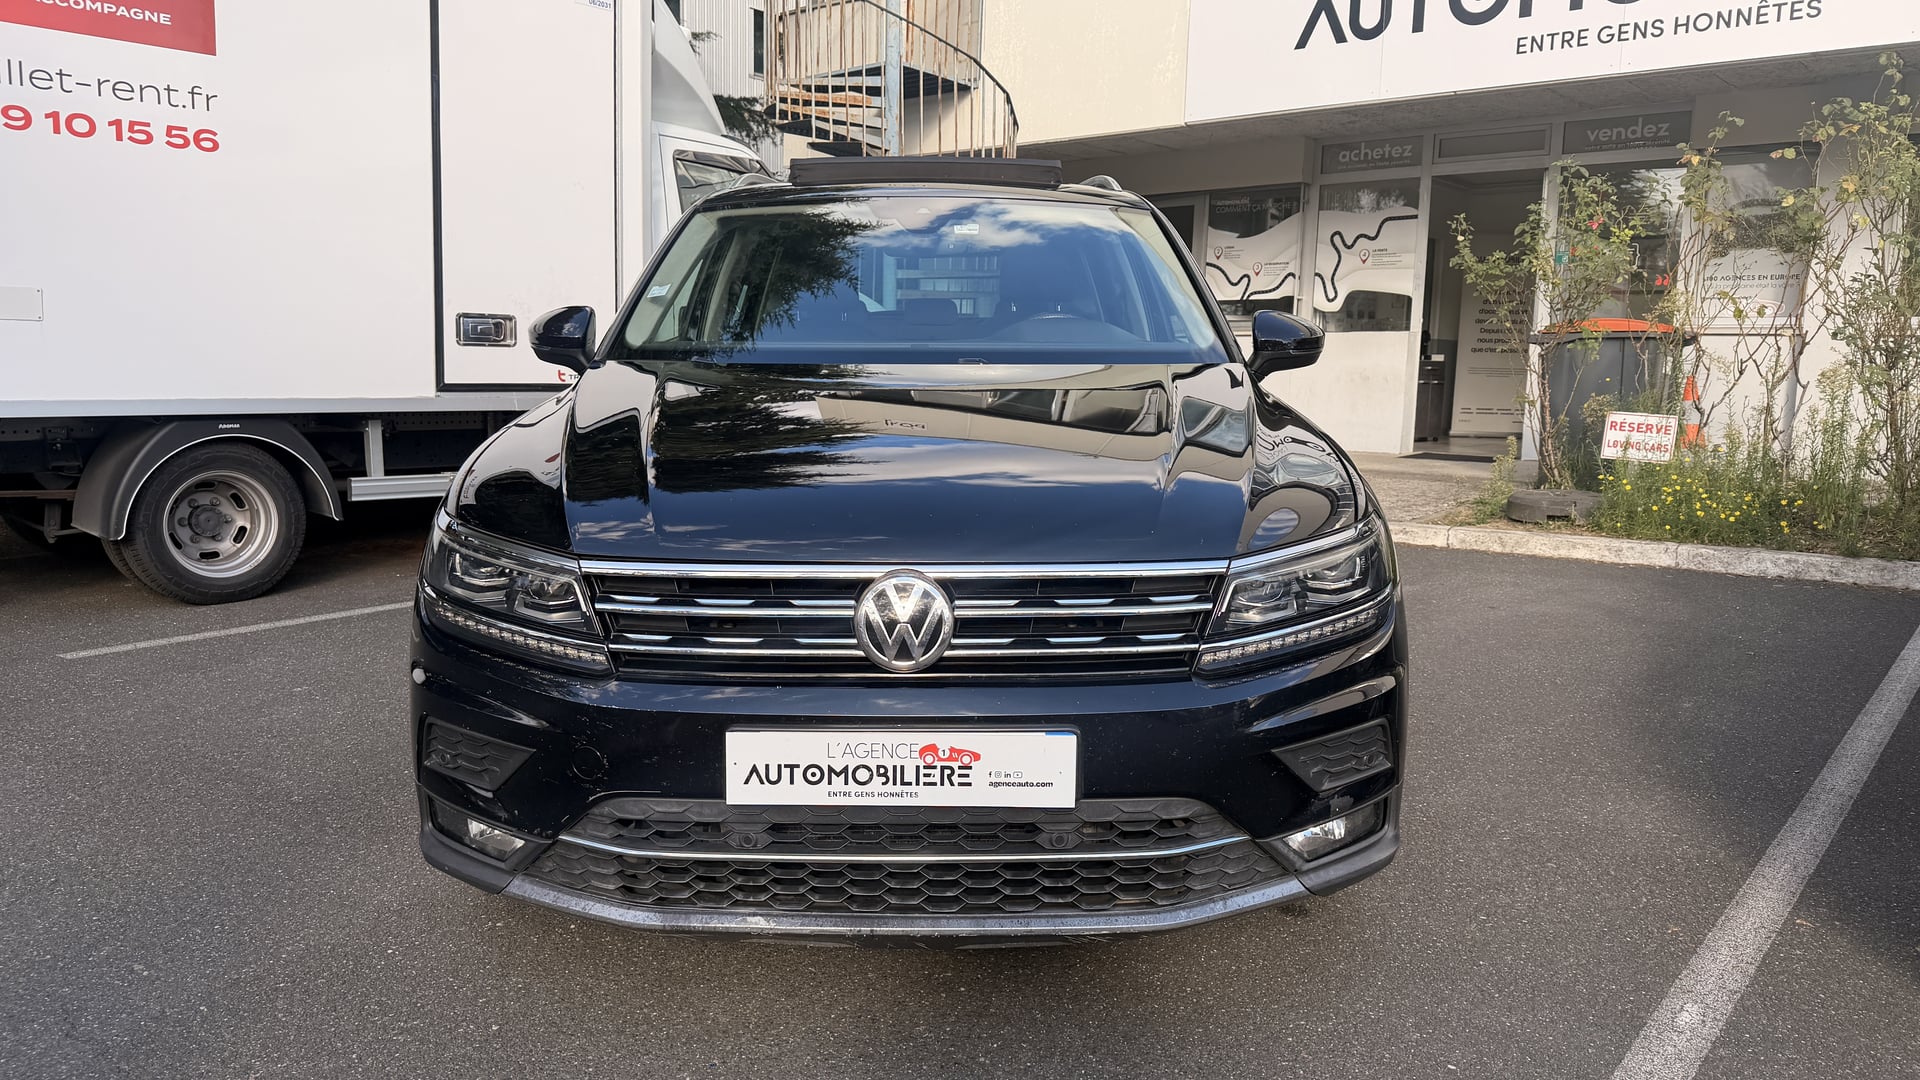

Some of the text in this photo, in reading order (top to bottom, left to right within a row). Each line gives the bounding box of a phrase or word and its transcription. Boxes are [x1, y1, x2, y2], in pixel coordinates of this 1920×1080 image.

[36, 0, 172, 25] COMPAGNE
[1516, 0, 1823, 55] ENTRE GENS HONNÊTES
[0, 58, 218, 111] llet-rent.fr
[44, 110, 97, 138] 10
[107, 118, 154, 145] 15
[165, 124, 220, 152] 56
[1586, 117, 1670, 141] vendez
[1338, 142, 1412, 162] achetez
[1643, 442, 1669, 453] CARS
[826, 742, 920, 760] L'AGENCE
[827, 788, 920, 799] ENTRE GENS HONNÊTES
[988, 780, 1054, 789] agenceauto.com
